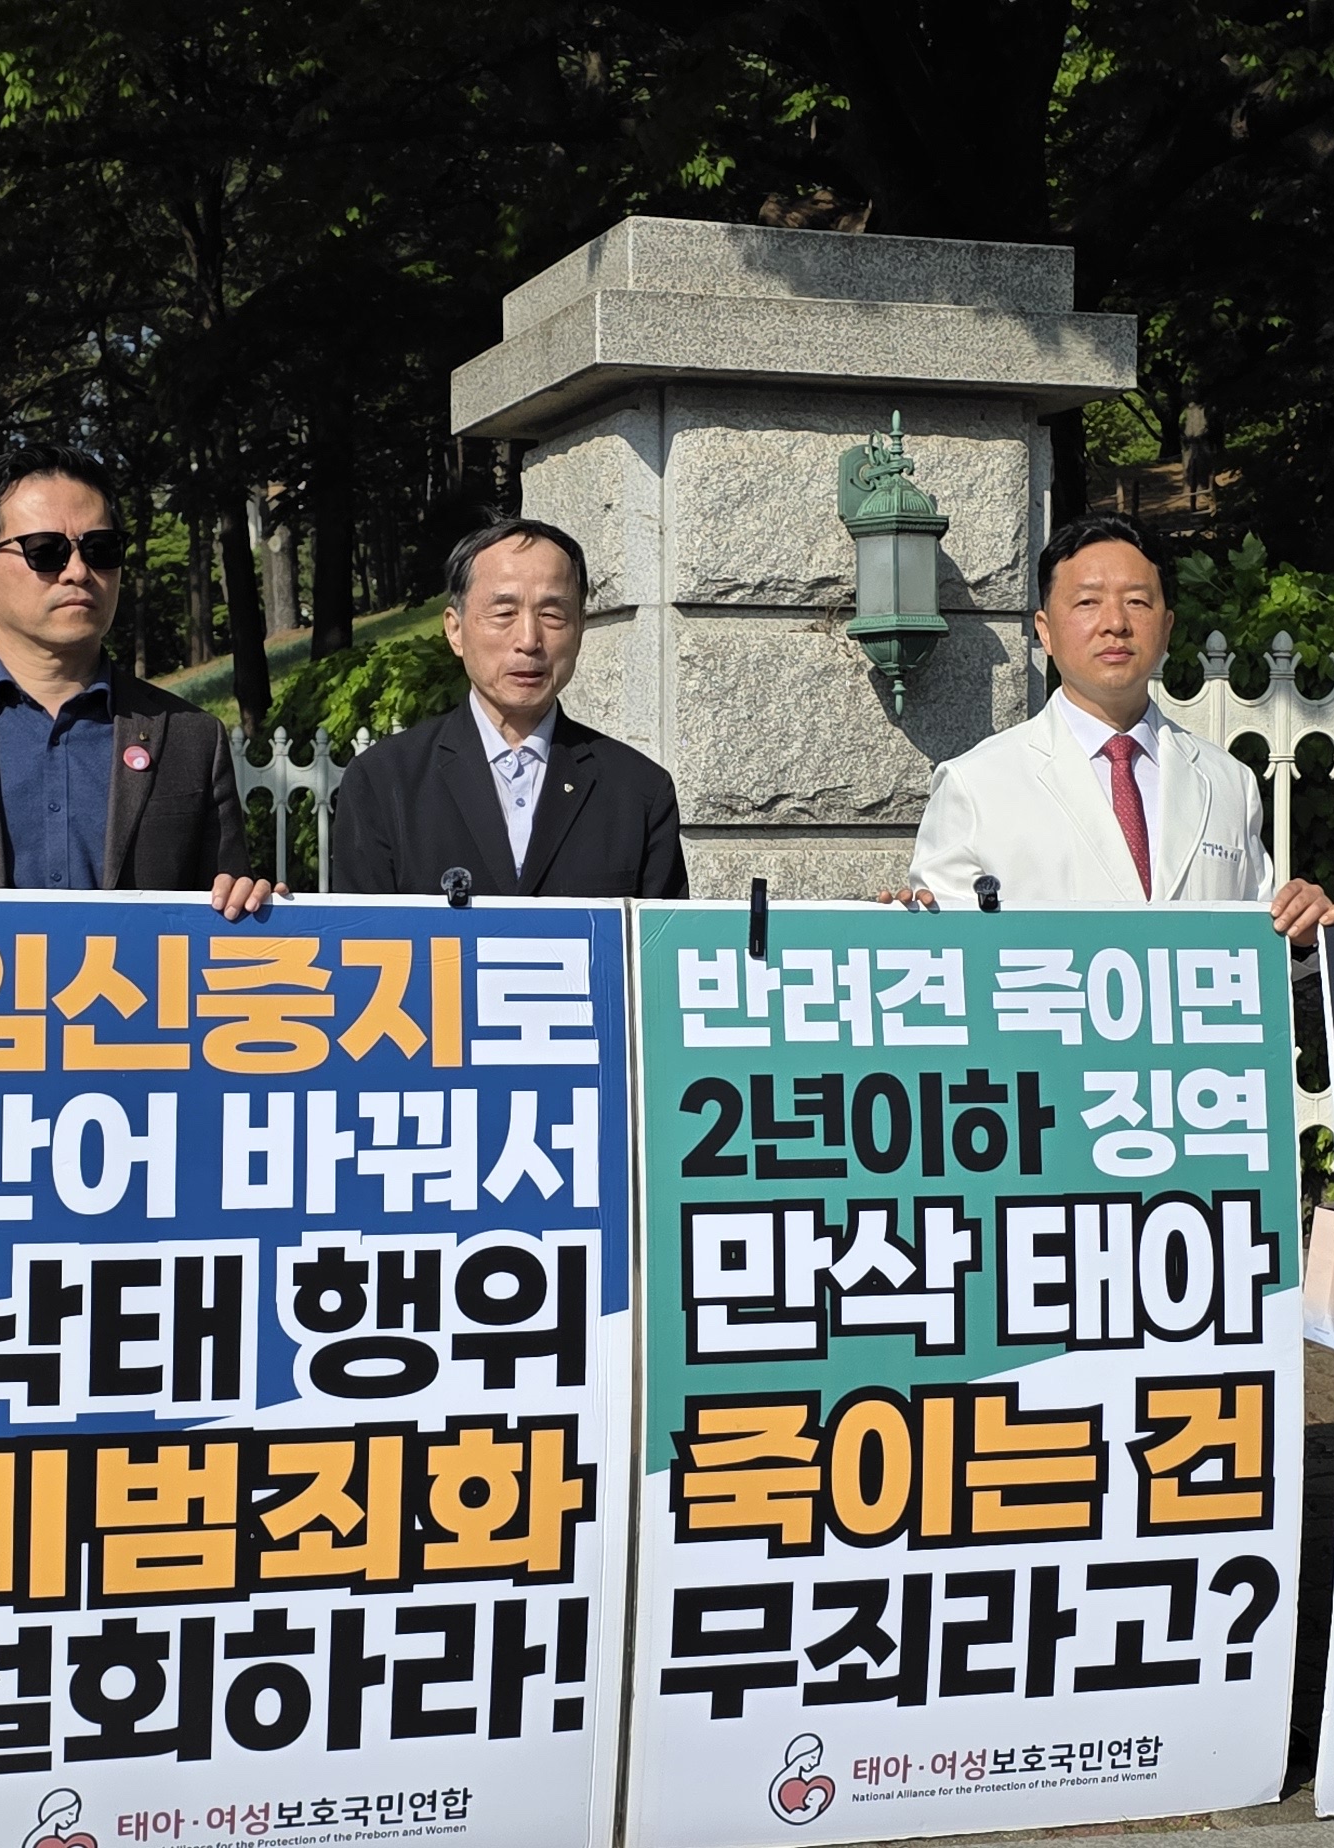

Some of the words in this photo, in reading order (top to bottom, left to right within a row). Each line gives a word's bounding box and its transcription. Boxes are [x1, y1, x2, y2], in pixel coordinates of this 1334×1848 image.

[677, 948, 968, 1048] 반려견
[992, 947, 1264, 1045] 죽이면
[221, 1087, 600, 1215] 바꿔서
[678, 1068, 1056, 1180] 2년이하
[1080, 1067, 1269, 1178] 징역
[292, 1245, 588, 1399] 행위
[691, 1206, 973, 1354] 만삭
[1005, 1200, 1270, 1341] 태아
[683, 1394, 1097, 1545] 죽이는
[1143, 1384, 1264, 1525] 건
[660, 1554, 1281, 1720] 무죄라고?
[257, 1835, 317, 1848] Protection
[319, 1832, 332, 1844] of
[333, 1831, 352, 1844] the
[355, 1827, 400, 1842] Preborn
[402, 1826, 423, 1838] and
[425, 1824, 467, 1836] Women
[852, 1790, 895, 1802] National
[896, 1787, 936, 1799] Alliance
[938, 1785, 954, 1796] for
[955, 1784, 972, 1795] the
[974, 1781, 1027, 1793] Protection
[1028, 1779, 1040, 1789] of
[1041, 1778, 1058, 1789] the
[1059, 1775, 1099, 1787] Preborn
[1101, 1773, 1119, 1784] and
[1121, 1771, 1158, 1782] Women
